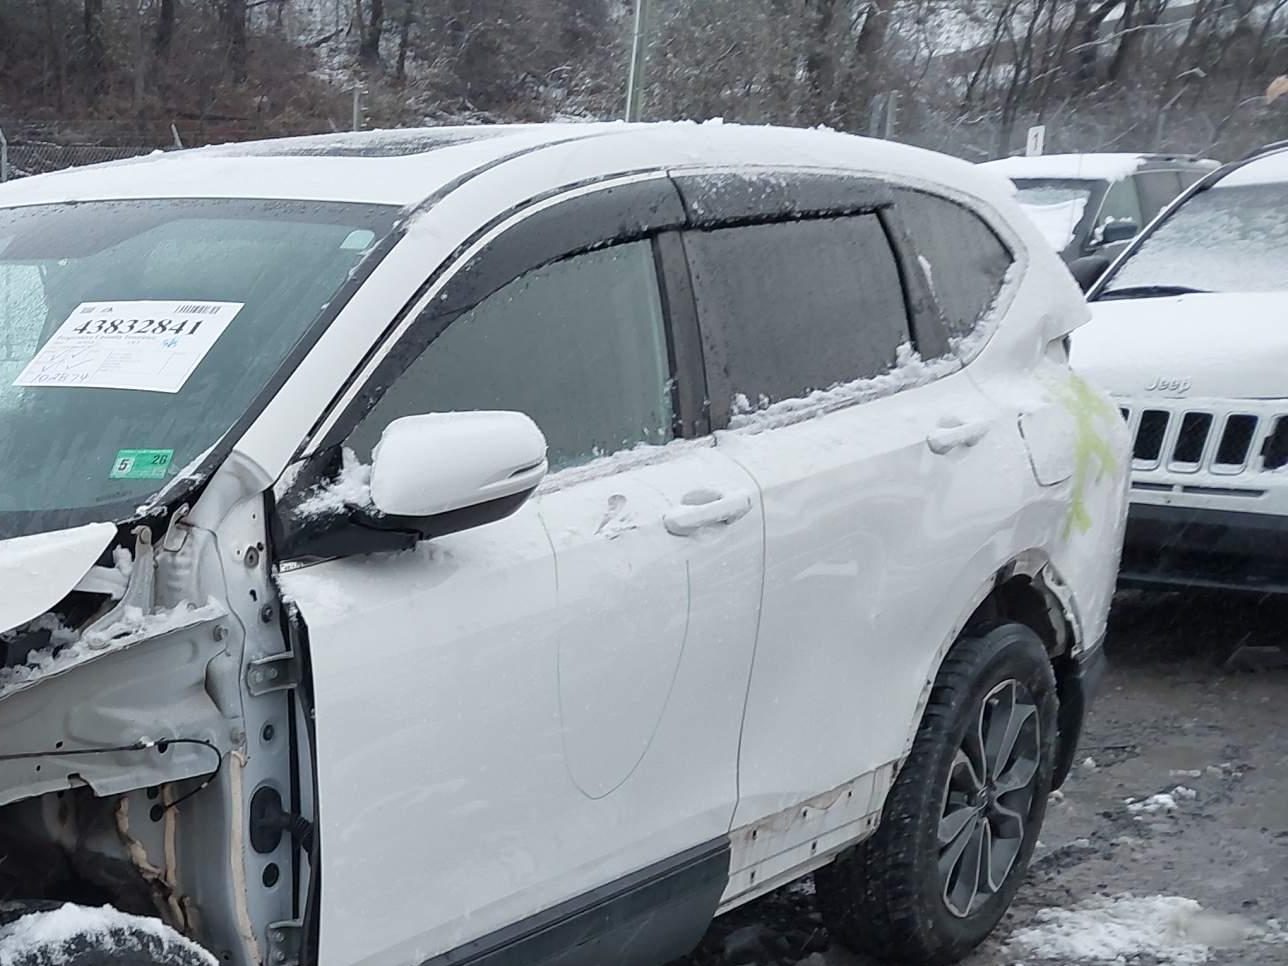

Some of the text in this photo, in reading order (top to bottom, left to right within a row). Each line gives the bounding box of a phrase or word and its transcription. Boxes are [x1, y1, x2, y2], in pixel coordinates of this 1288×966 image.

[74, 319, 204, 335] 43832841
[1143, 376, 1192, 394] Jeep
[118, 454, 169, 471] 5 26
